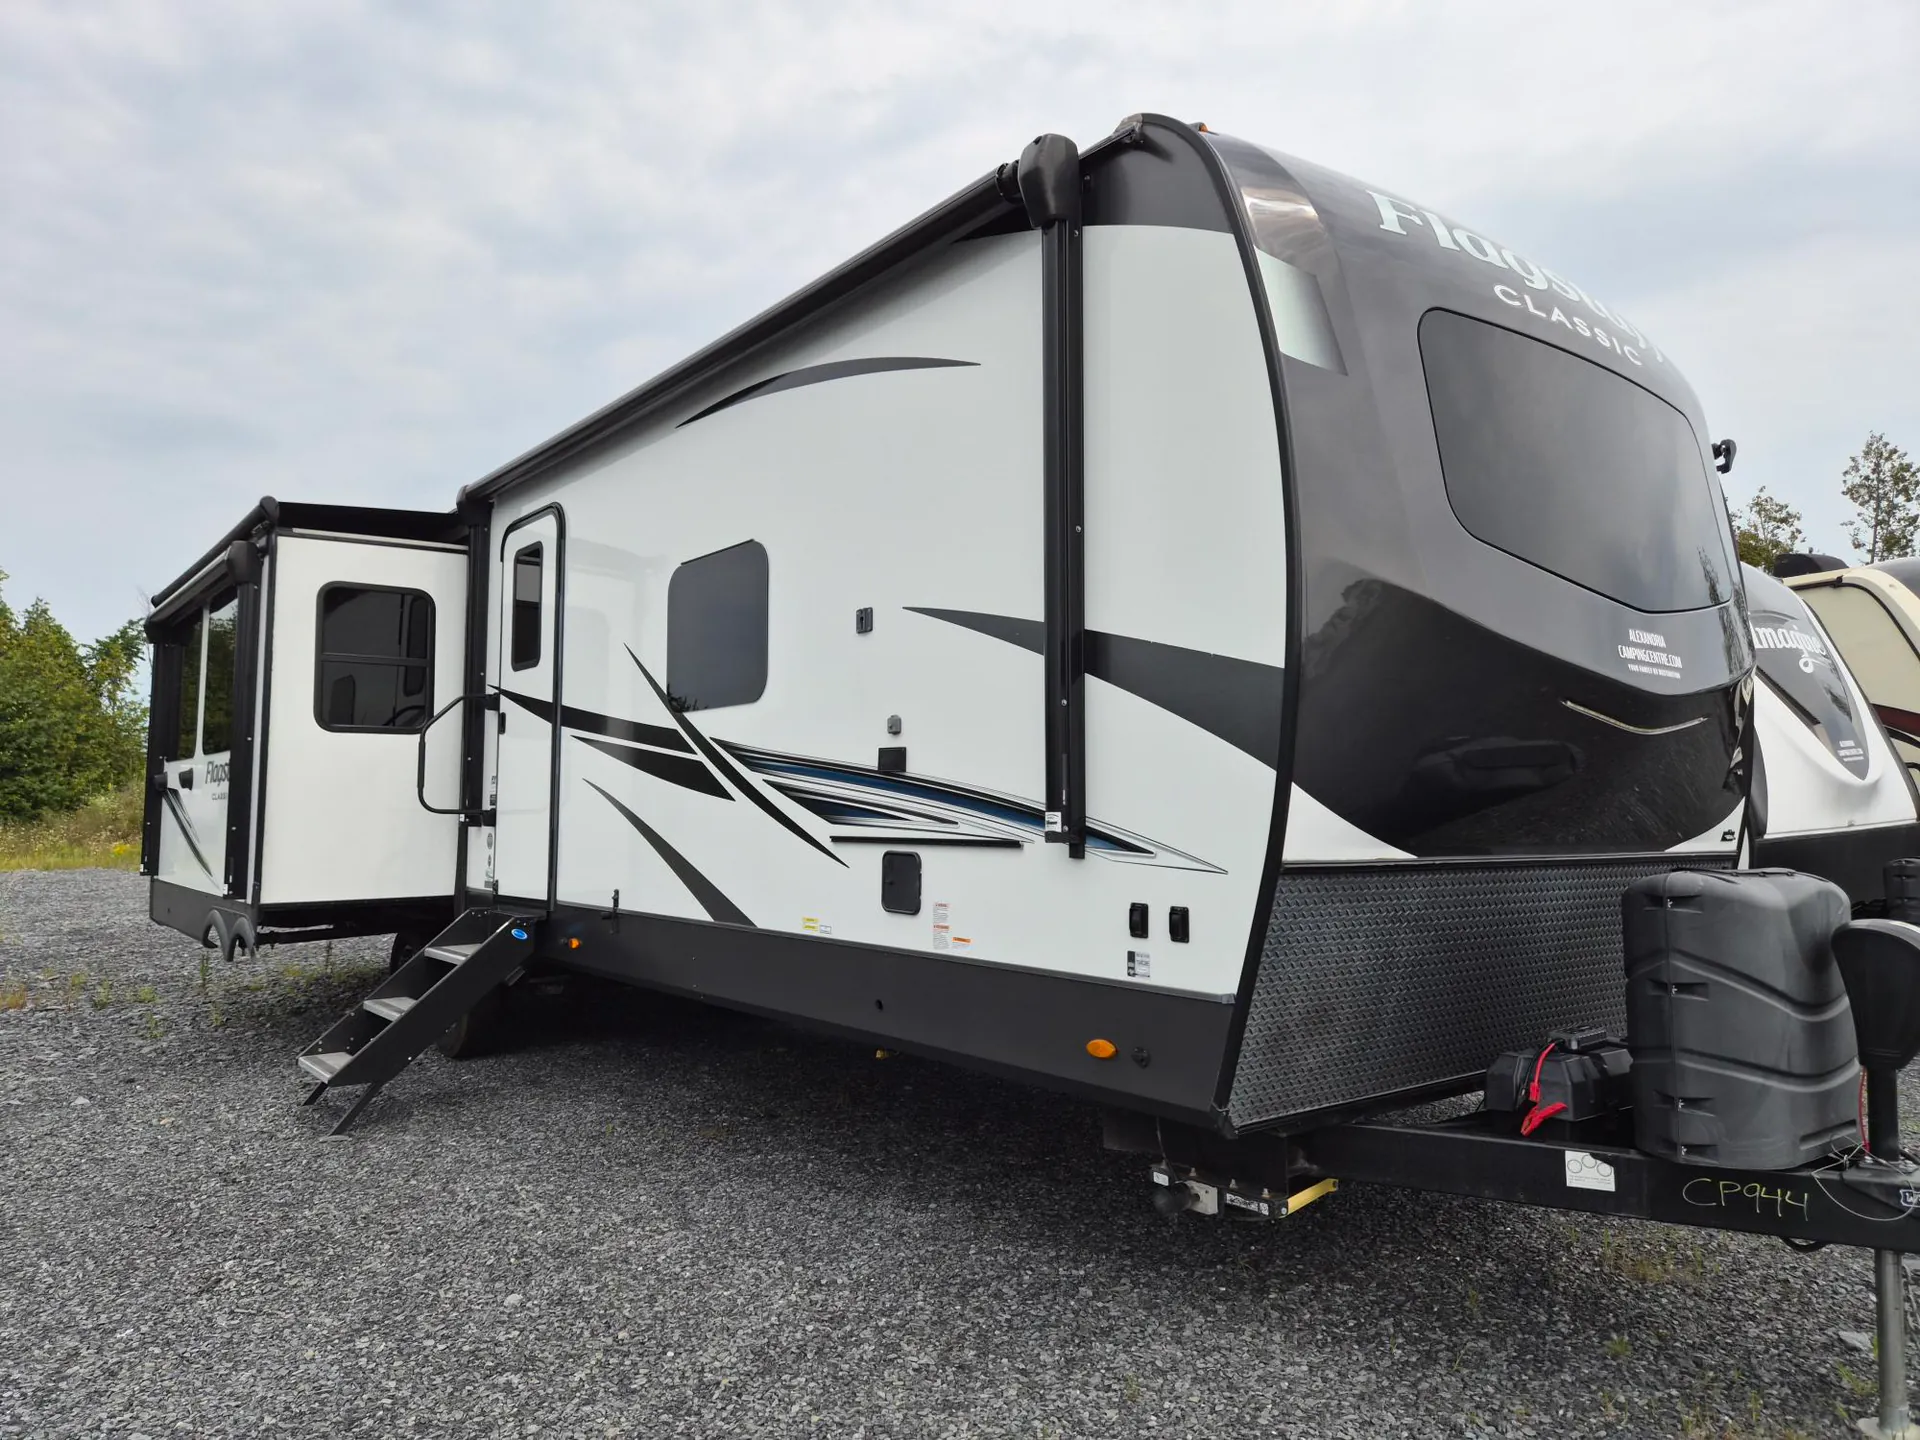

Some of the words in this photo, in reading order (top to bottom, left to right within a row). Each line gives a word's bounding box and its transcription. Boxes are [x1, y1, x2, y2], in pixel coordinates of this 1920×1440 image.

[1365, 190, 1663, 363] Flagsta
[1493, 283, 1643, 366] CLASSIC
[1682, 1177, 1809, 1221] CP944
